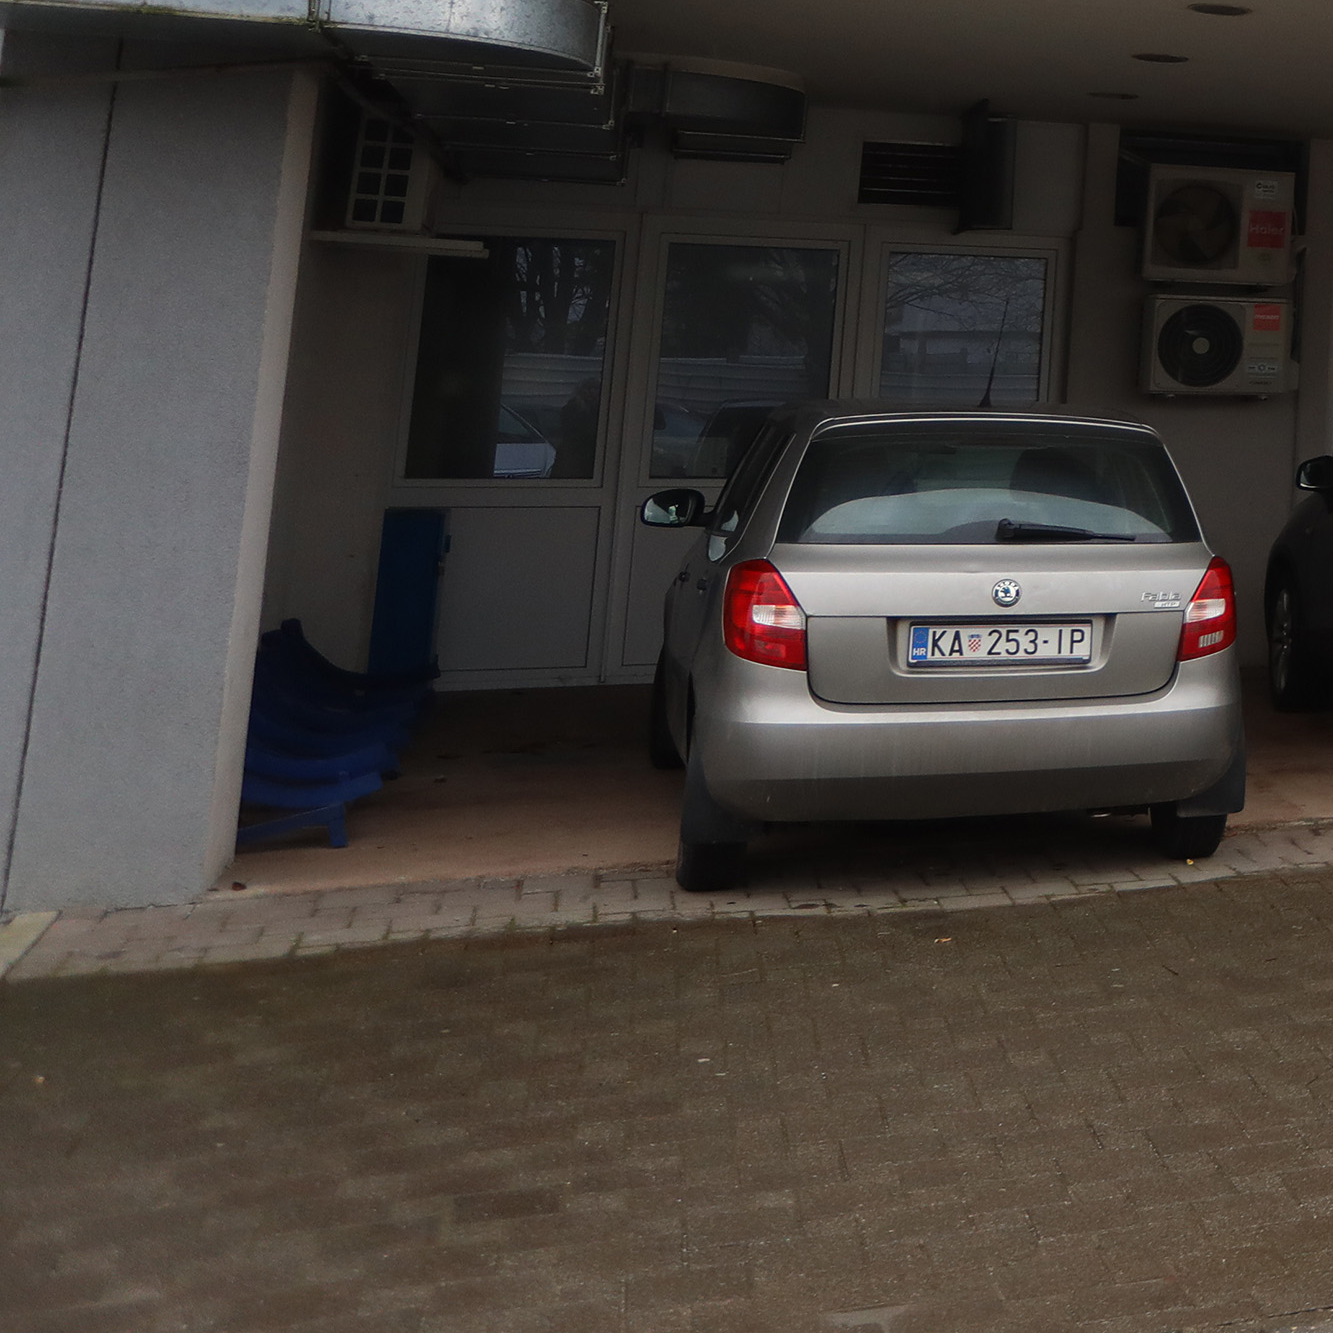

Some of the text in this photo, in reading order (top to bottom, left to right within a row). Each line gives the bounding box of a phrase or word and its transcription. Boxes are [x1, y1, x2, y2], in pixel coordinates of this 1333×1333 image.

[1141, 591, 1182, 602] Fabia
[930, 628, 1086, 658] KA 253-IP
[912, 647, 927, 657] HR
